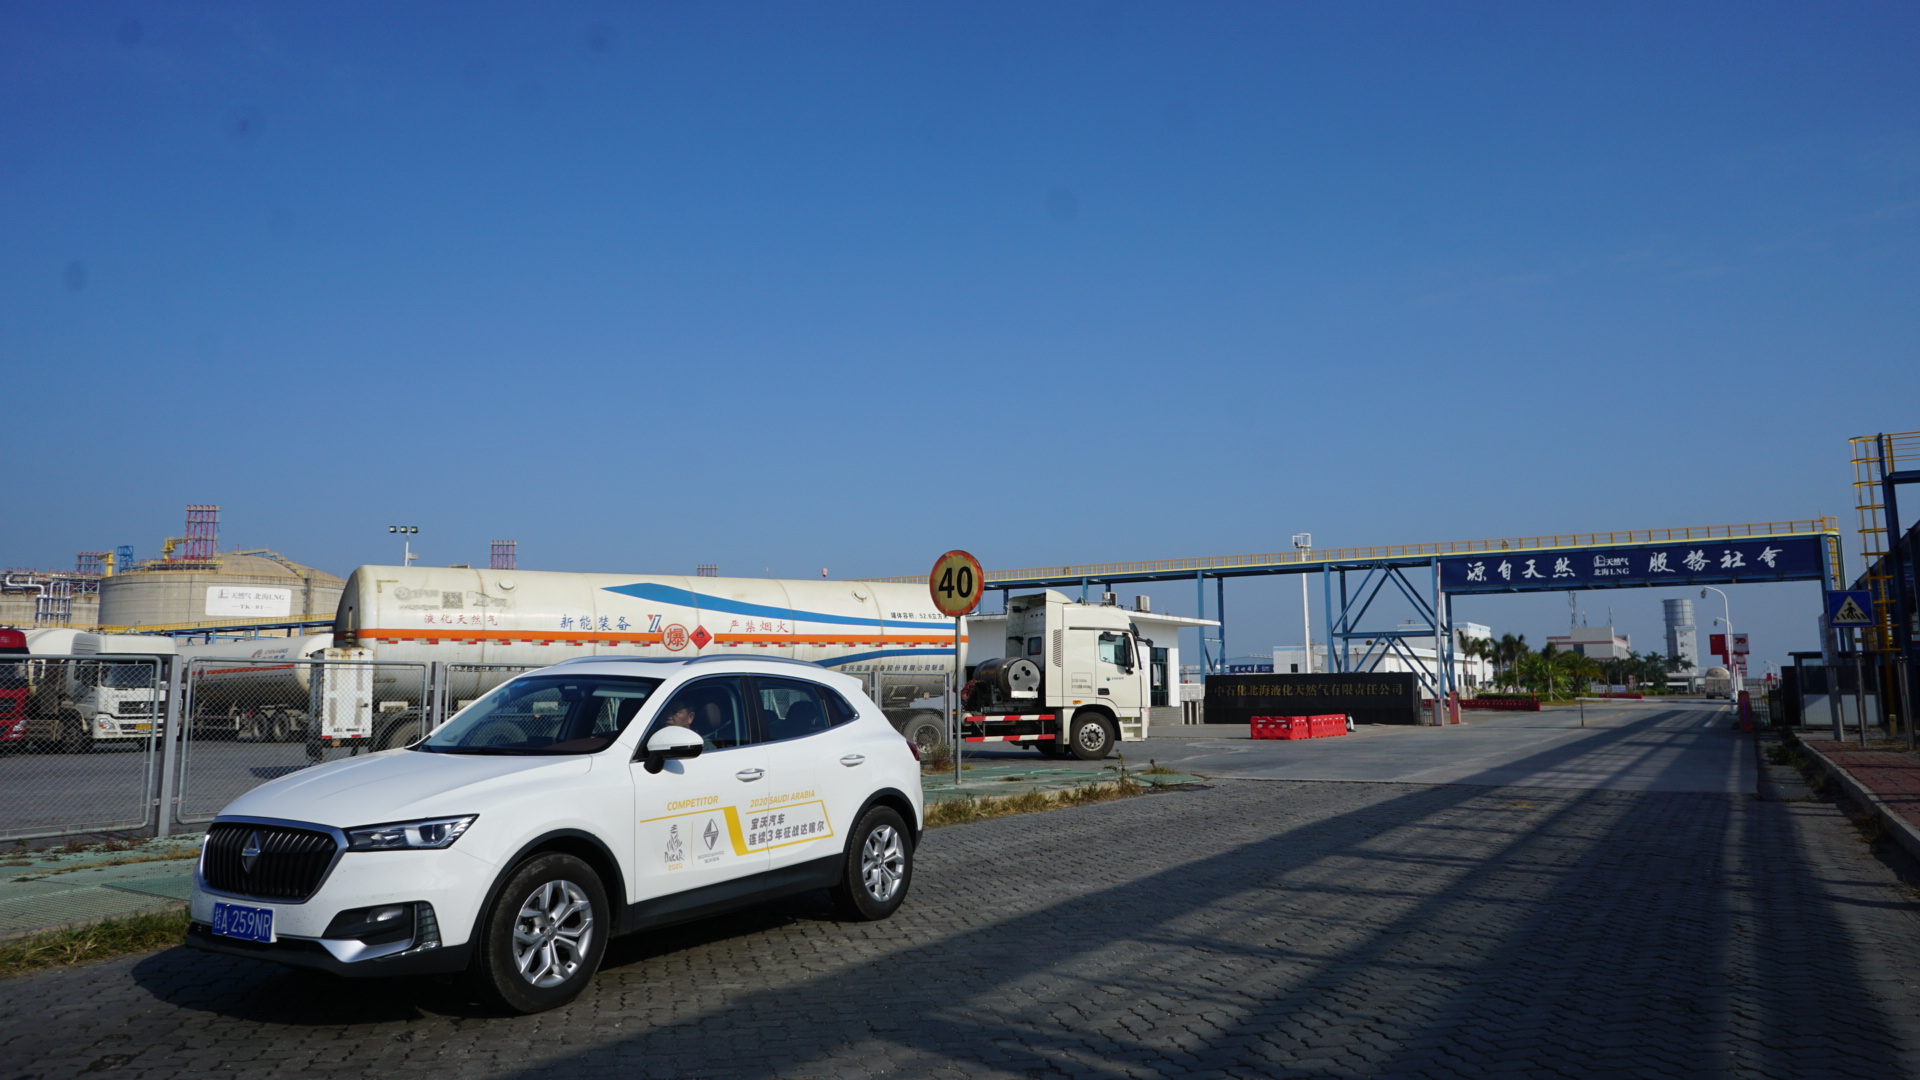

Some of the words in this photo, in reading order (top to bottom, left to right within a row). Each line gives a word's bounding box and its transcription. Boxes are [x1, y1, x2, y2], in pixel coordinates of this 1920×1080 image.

[1466, 556, 1576, 582] 源自天然
[1605, 557, 1630, 567] 天然气
[1593, 567, 1630, 577] 北海LNG
[938, 566, 973, 599] 40
[424, 613, 499, 627] 液化天然气
[560, 614, 632, 631] 新能装备
[729, 619, 789, 633] 严禁烟火
[666, 627, 686, 647] 爆
[840, 663, 945, 672] 新兴能源装备股份有限公司制造
[1213, 682, 1403, 697] 中石化北海液化天然气有限责任公司
[666, 794, 719, 812] COMPETITOR
[749, 797, 768, 808] 2020
[768, 794, 790, 805] SAUDI
[790, 789, 816, 801] ARABIA
[750, 813, 786, 831] 宝沃汽车
[748, 820, 825, 846] 连续3年征战达喀尔
[667, 863, 683, 872] 2020
